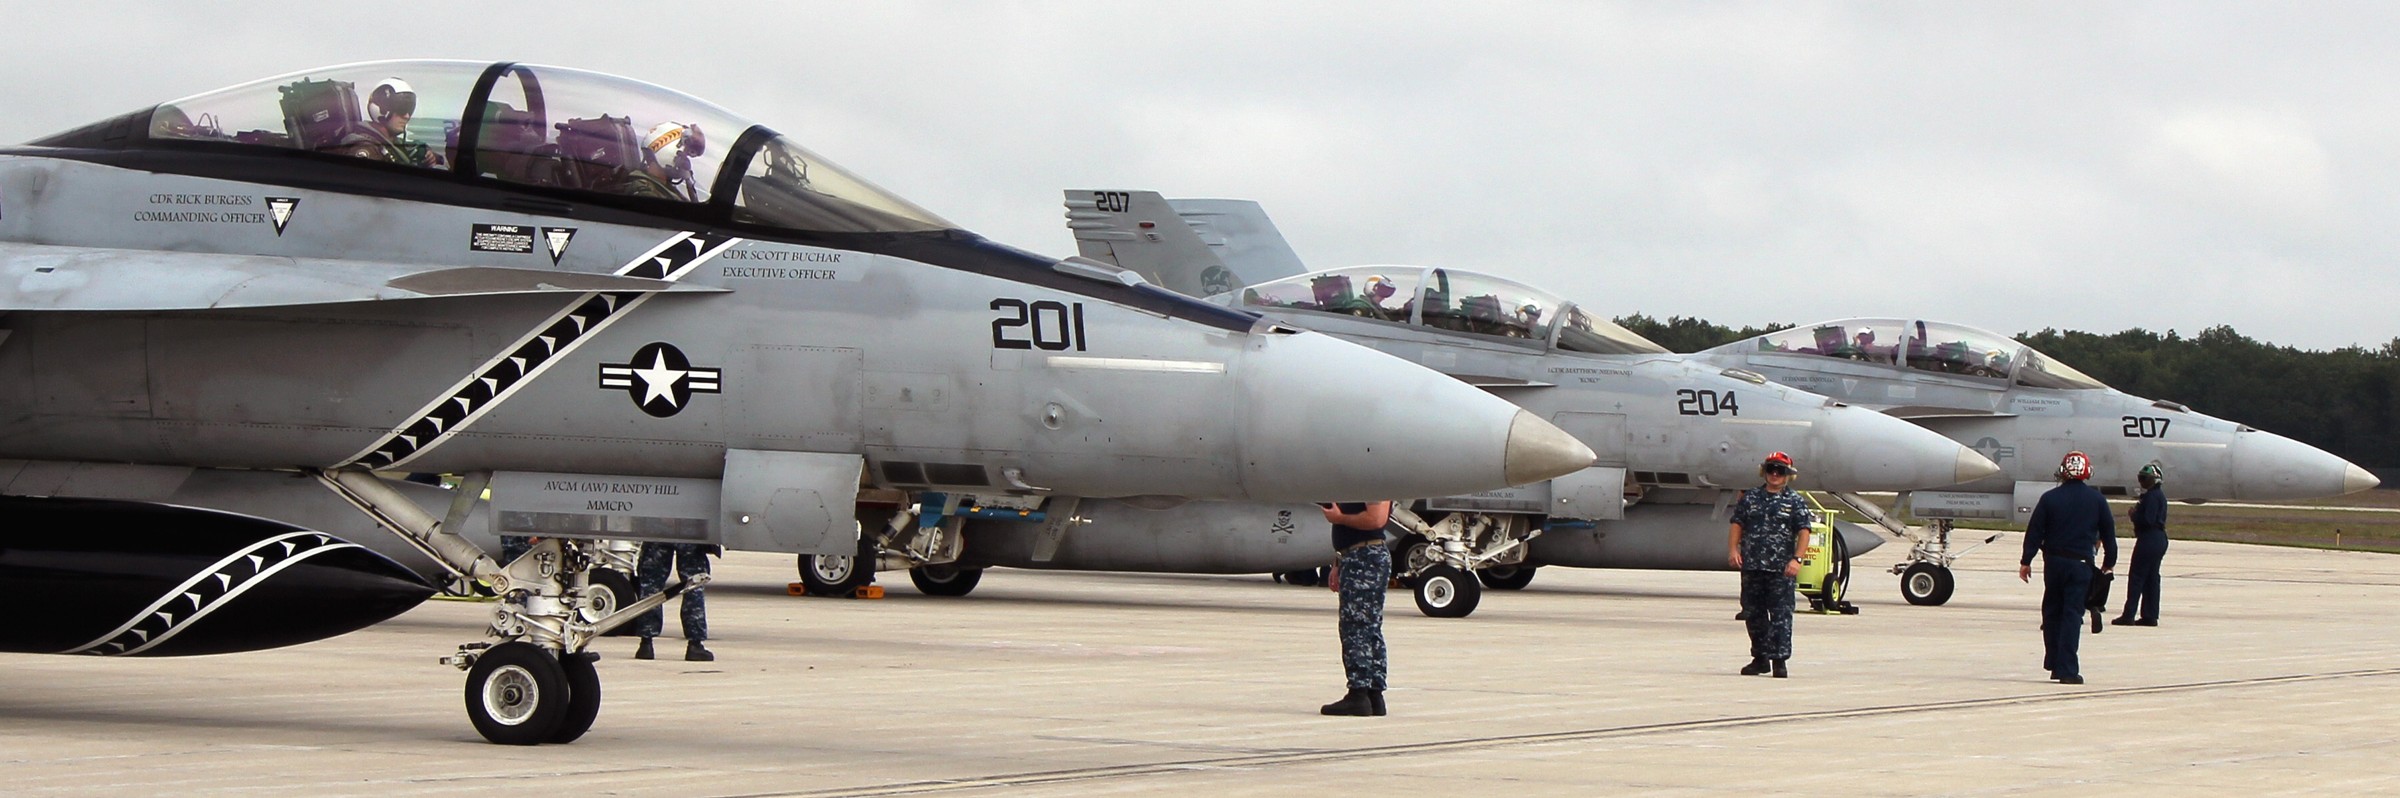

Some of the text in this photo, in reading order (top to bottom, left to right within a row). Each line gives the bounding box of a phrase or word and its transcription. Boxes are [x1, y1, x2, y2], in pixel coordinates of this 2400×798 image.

[150, 194, 252, 206] CDR RICK BURGESS
[1094, 191, 1130, 213] 207
[134, 211, 218, 223] COMMANDING
[220, 212, 265, 224] OFFICER
[490, 225, 518, 233] WARNING
[722, 249, 841, 263] CDR SCOTT BUCHAR
[722, 267, 836, 280] EXECUTIVE OFFICER
[990, 298, 1086, 351] 201
[1677, 389, 1739, 416] 204
[2122, 416, 2171, 438] 207
[544, 481, 680, 495] AVCM (AW) RANDY HILL
[586, 500, 633, 511] MMCPO
